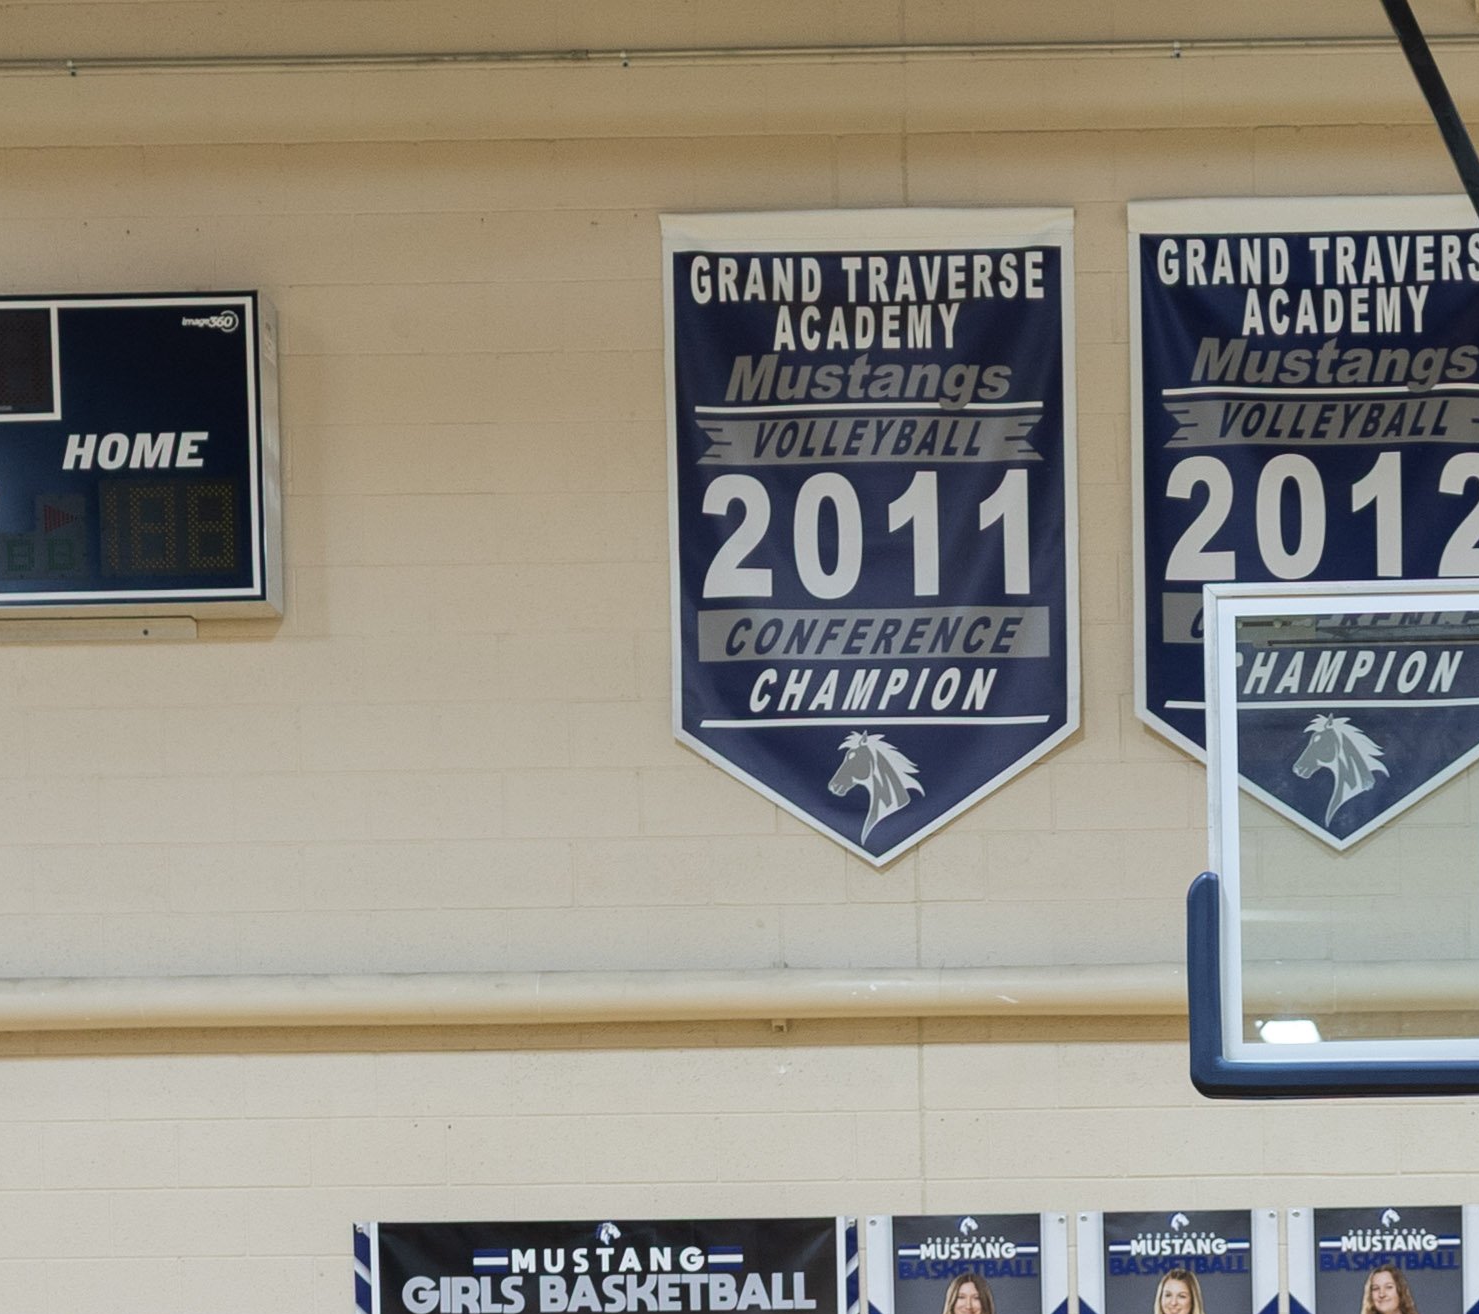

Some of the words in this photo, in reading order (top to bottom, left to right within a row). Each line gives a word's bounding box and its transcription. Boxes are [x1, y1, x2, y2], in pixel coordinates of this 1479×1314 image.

[690, 255, 824, 305] GRAND
[842, 249, 1045, 302] TRAVERSE
[1157, 237, 1290, 286] GRAND
[773, 303, 960, 351] ACADEMY
[1241, 285, 1429, 335] ACADEMY
[725, 352, 1011, 410] Mustangs
[1191, 336, 1479, 392] Mustangs
[752, 418, 983, 459] VOLLEYBALL
[1217, 401, 1450, 441] VOLLEYBALL
[62, 431, 209, 471] HOME
[702, 468, 1032, 599] 2011
[725, 615, 1018, 657] CONFERENCE
[749, 666, 997, 712] CHAMPION
[1236, 650, 1464, 694] HAMPION
[510, 1247, 706, 1274] MUSTANG
[920, 1242, 1017, 1260] MUSTANG
[1131, 1237, 1227, 1256] MUSTANG
[1342, 1234, 1438, 1252] MUSTANG
[539, 1272, 817, 1313] BASKETBALL
